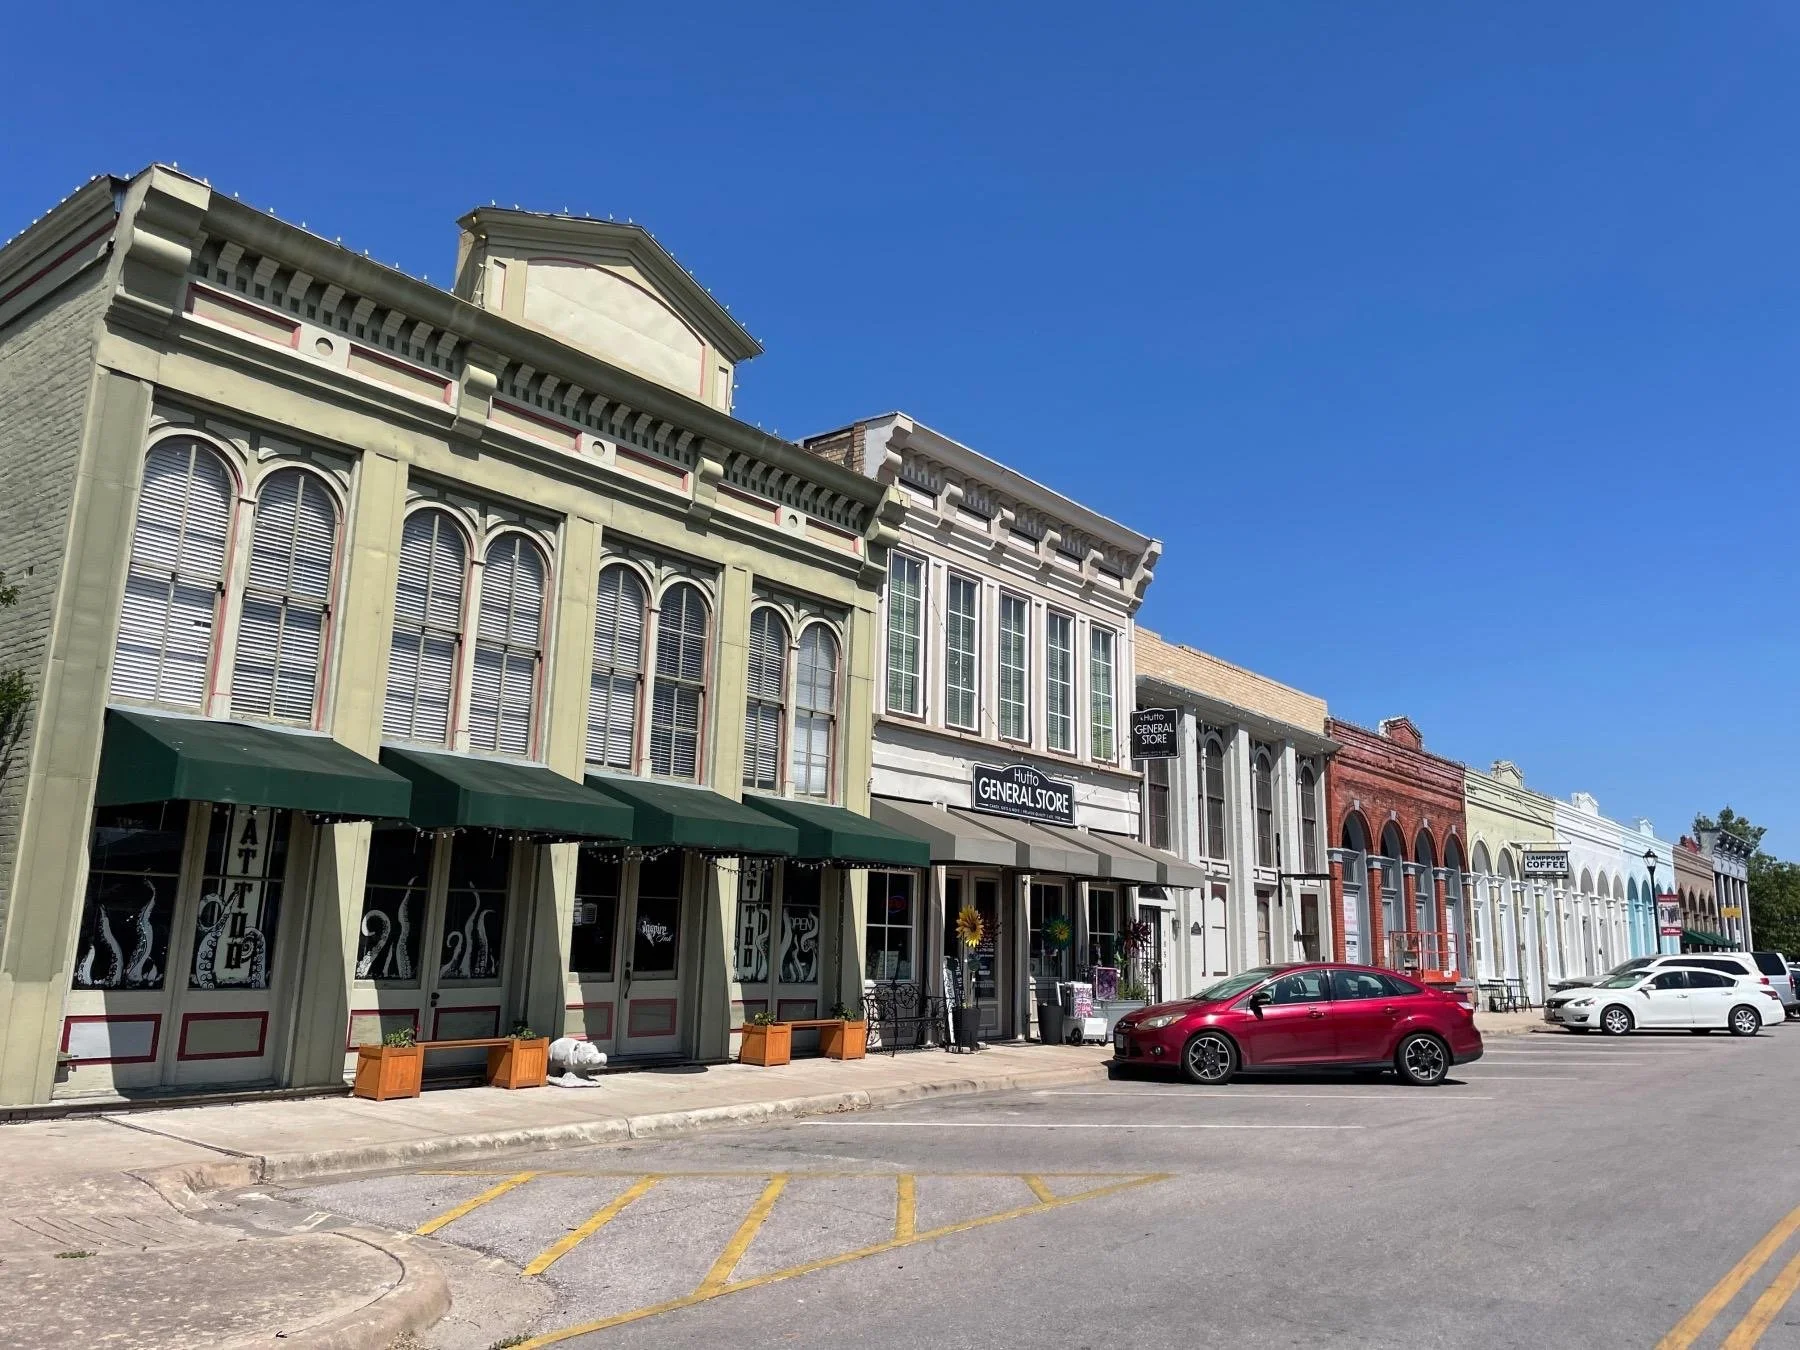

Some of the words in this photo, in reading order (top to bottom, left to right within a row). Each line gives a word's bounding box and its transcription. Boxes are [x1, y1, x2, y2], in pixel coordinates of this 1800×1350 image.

[1143, 713, 1164, 721] Hutto
[1135, 723, 1174, 734] GENERAL
[1141, 733, 1167, 744] STORE
[1014, 768, 1039, 786] Hutto
[979, 777, 1034, 807] GENERAL
[1036, 788, 1069, 813] STORE
[224, 806, 259, 969] ATTOO
[743, 860, 757, 967] ATTOO
